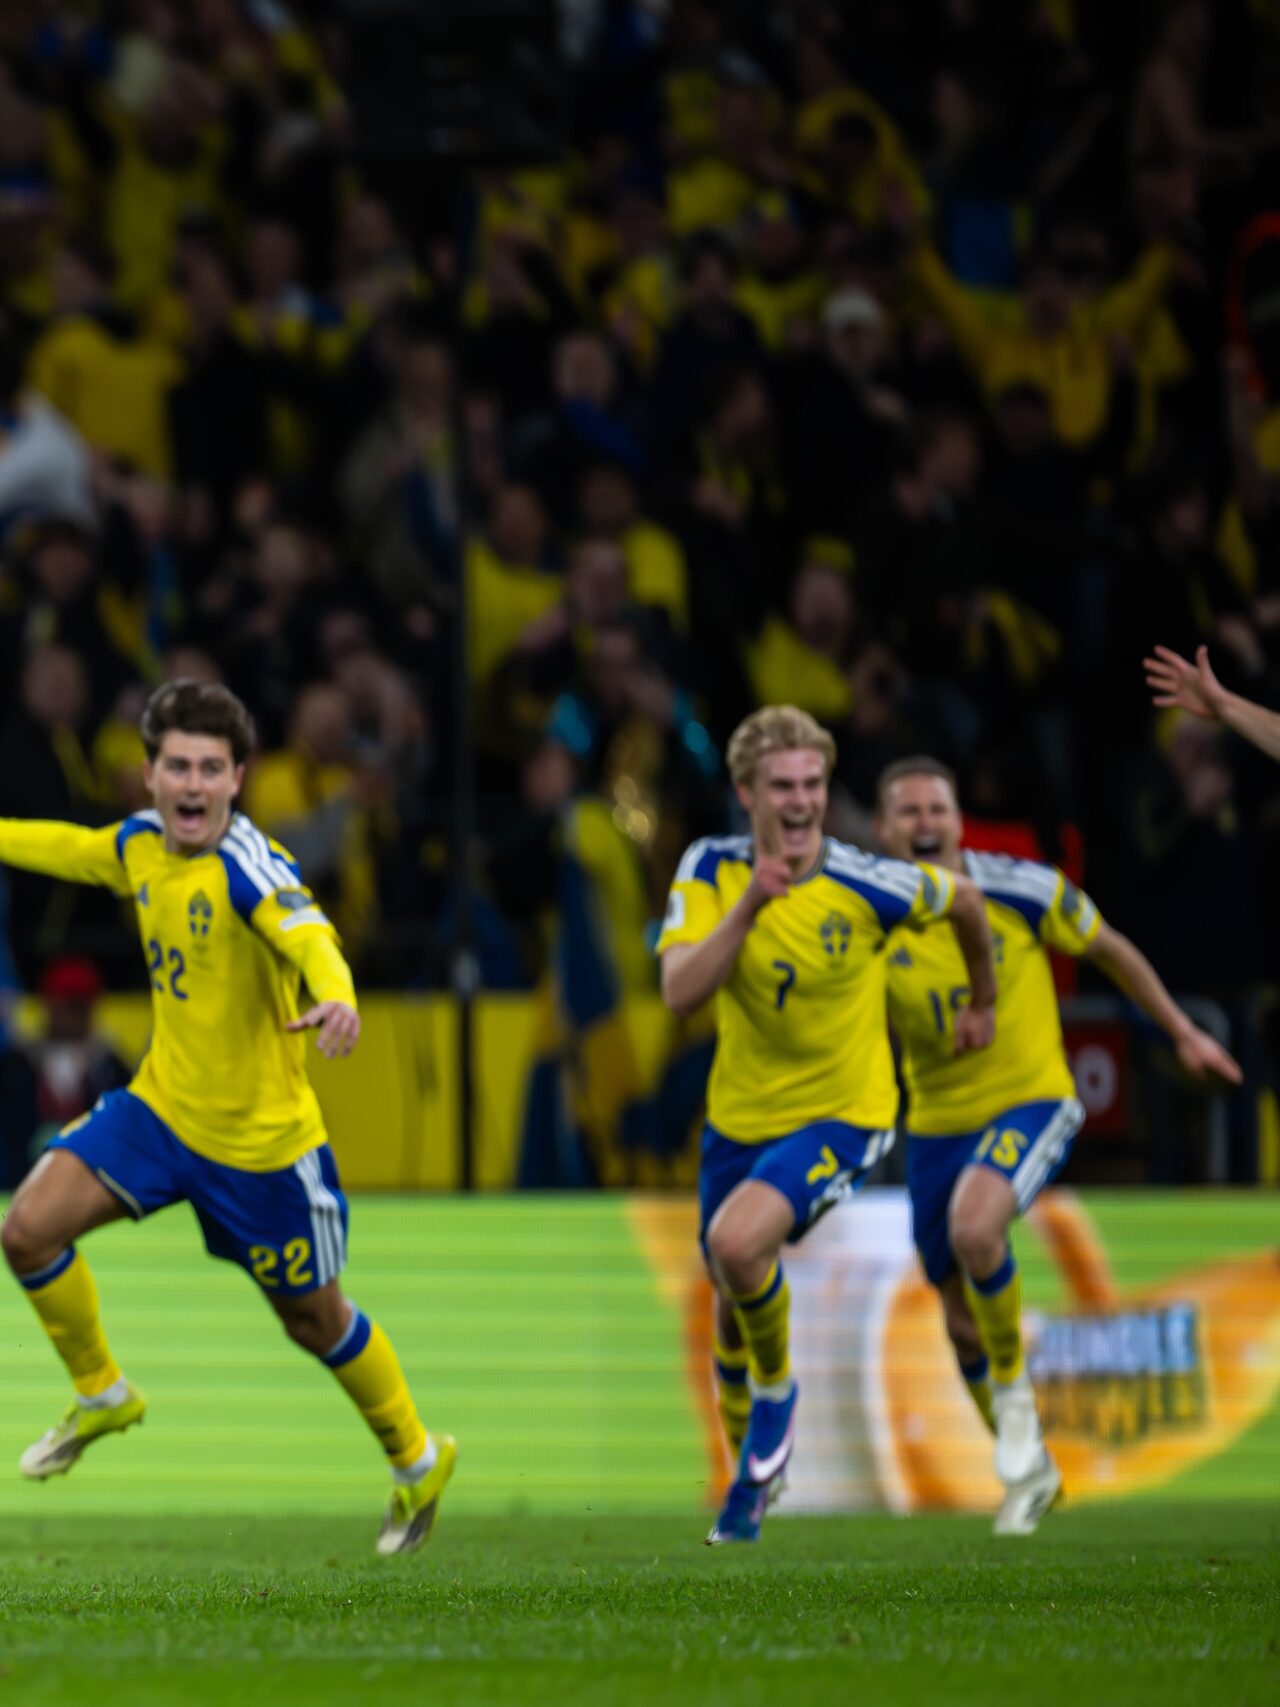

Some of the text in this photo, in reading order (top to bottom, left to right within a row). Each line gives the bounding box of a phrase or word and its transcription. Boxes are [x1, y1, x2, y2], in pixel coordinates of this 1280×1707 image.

[148, 936, 188, 1000] 22
[773, 959, 796, 1010] 7
[805, 1144, 839, 1186] 7
[974, 1126, 1028, 1170] 15
[248, 1235, 314, 1288] 22
